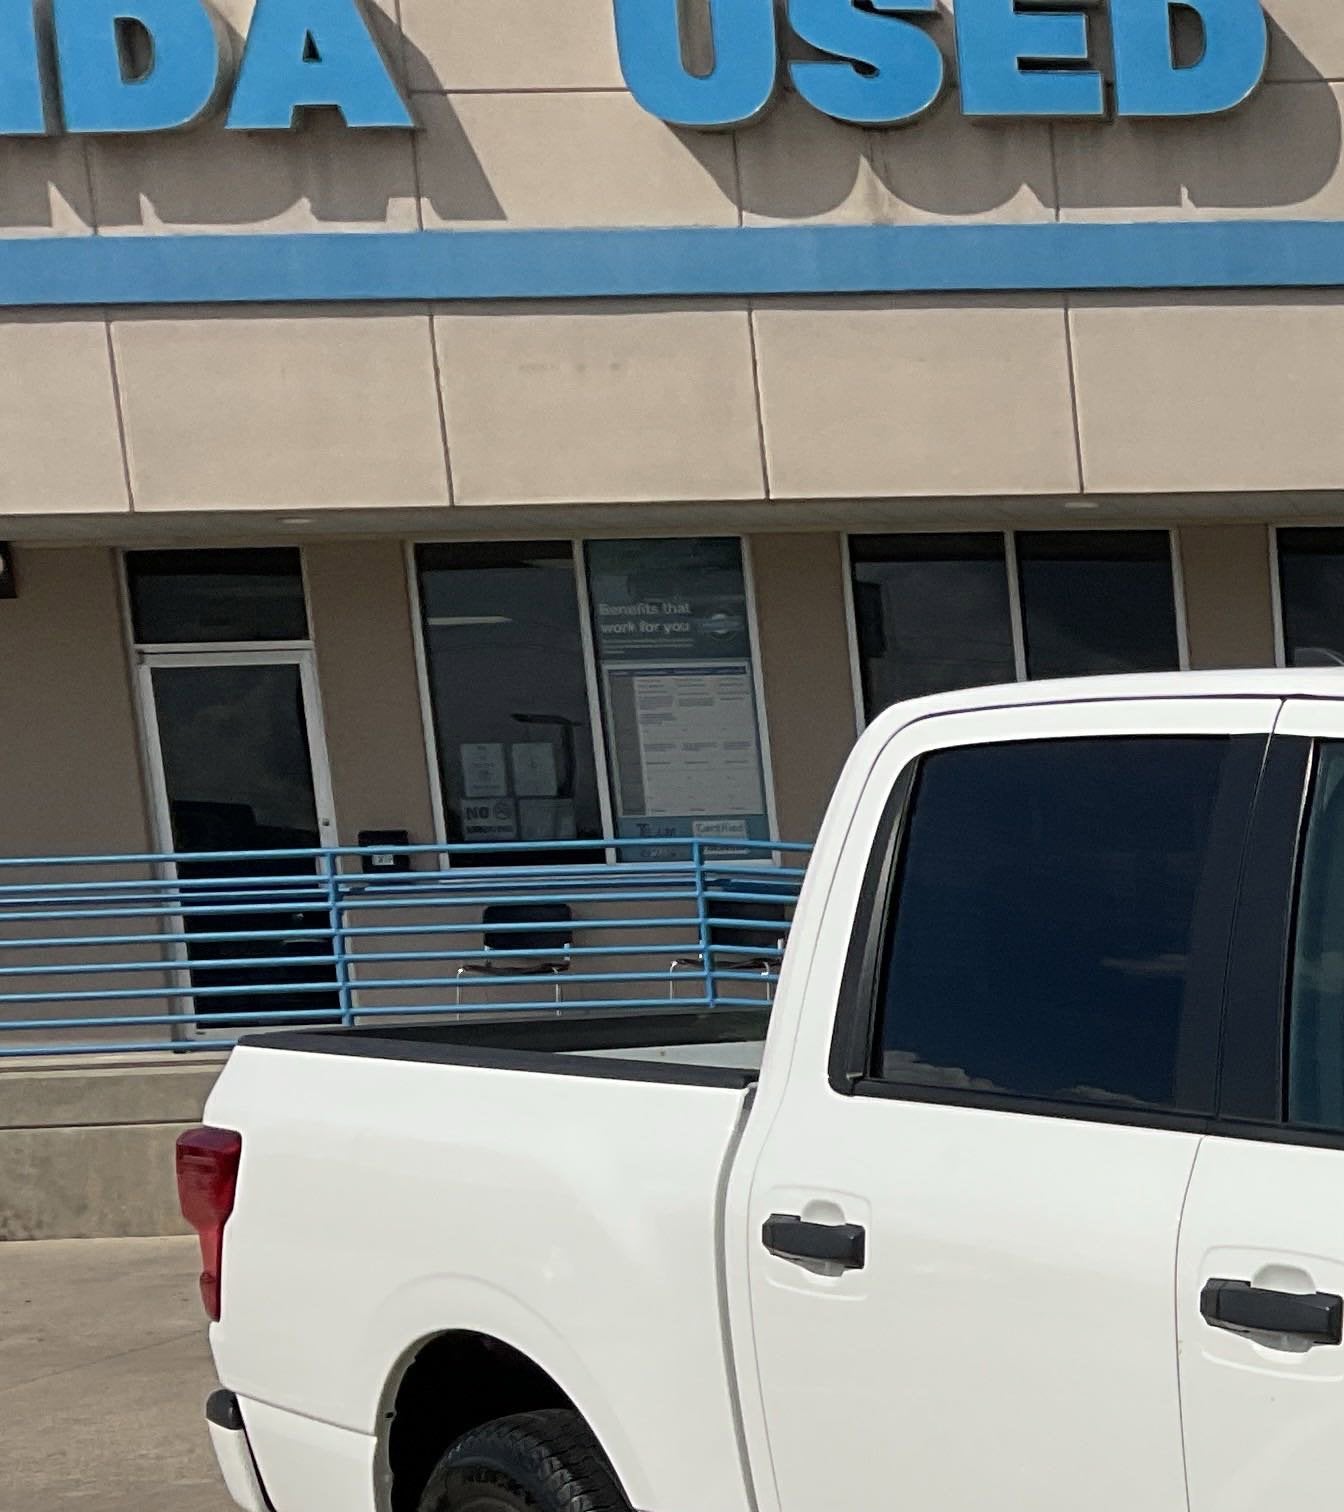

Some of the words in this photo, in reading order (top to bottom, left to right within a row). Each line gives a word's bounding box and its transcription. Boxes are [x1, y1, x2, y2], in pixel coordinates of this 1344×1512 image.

[0, 0, 417, 135] DA
[612, 0, 1270, 127] USED
[599, 602, 659, 616] Benefits
[661, 601, 691, 616] that
[600, 621, 635, 633] work
[639, 620, 660, 632] for
[663, 621, 691, 635] you
